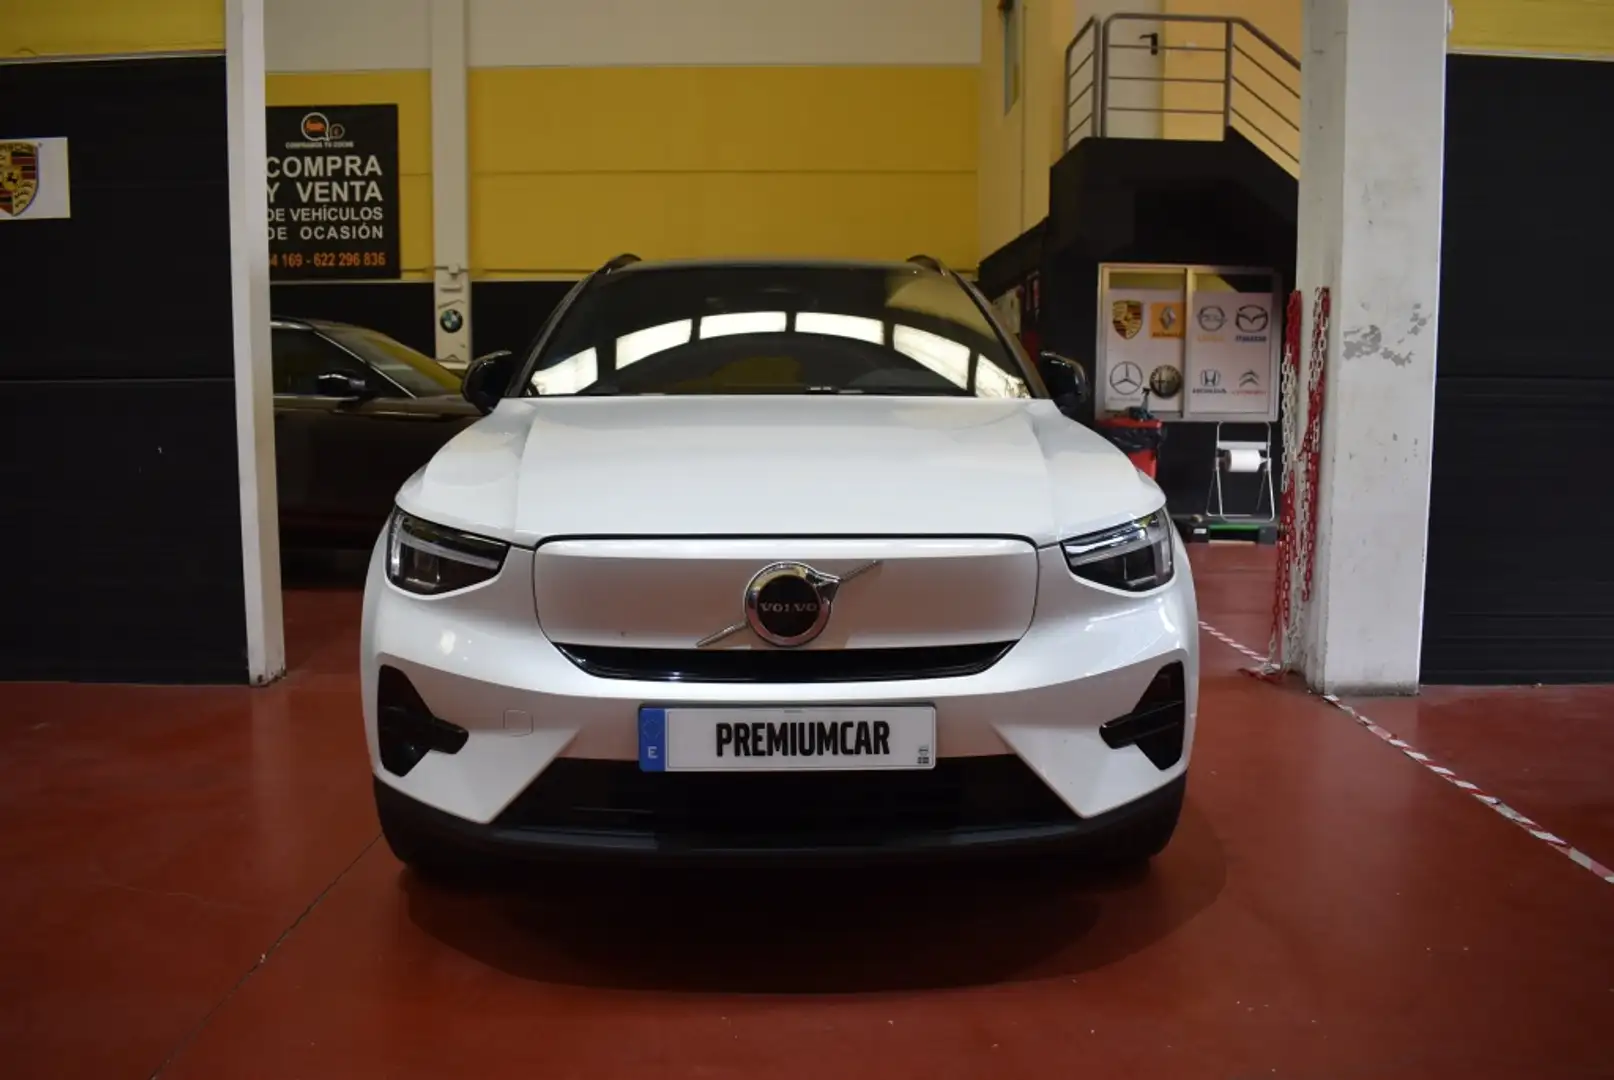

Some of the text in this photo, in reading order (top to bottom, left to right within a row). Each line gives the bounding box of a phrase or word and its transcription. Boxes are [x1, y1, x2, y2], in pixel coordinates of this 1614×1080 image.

[267, 155, 382, 178] COMPRA
[267, 181, 384, 203] Y VENTA
[267, 204, 383, 221] DE VEHÍCULOS
[300, 221, 383, 239] OCASIÓN
[282, 253, 302, 267] 169
[313, 252, 336, 267] 622
[339, 252, 360, 266] 296
[715, 720, 890, 757] PREMIUMCAR
[648, 746, 658, 759] E
